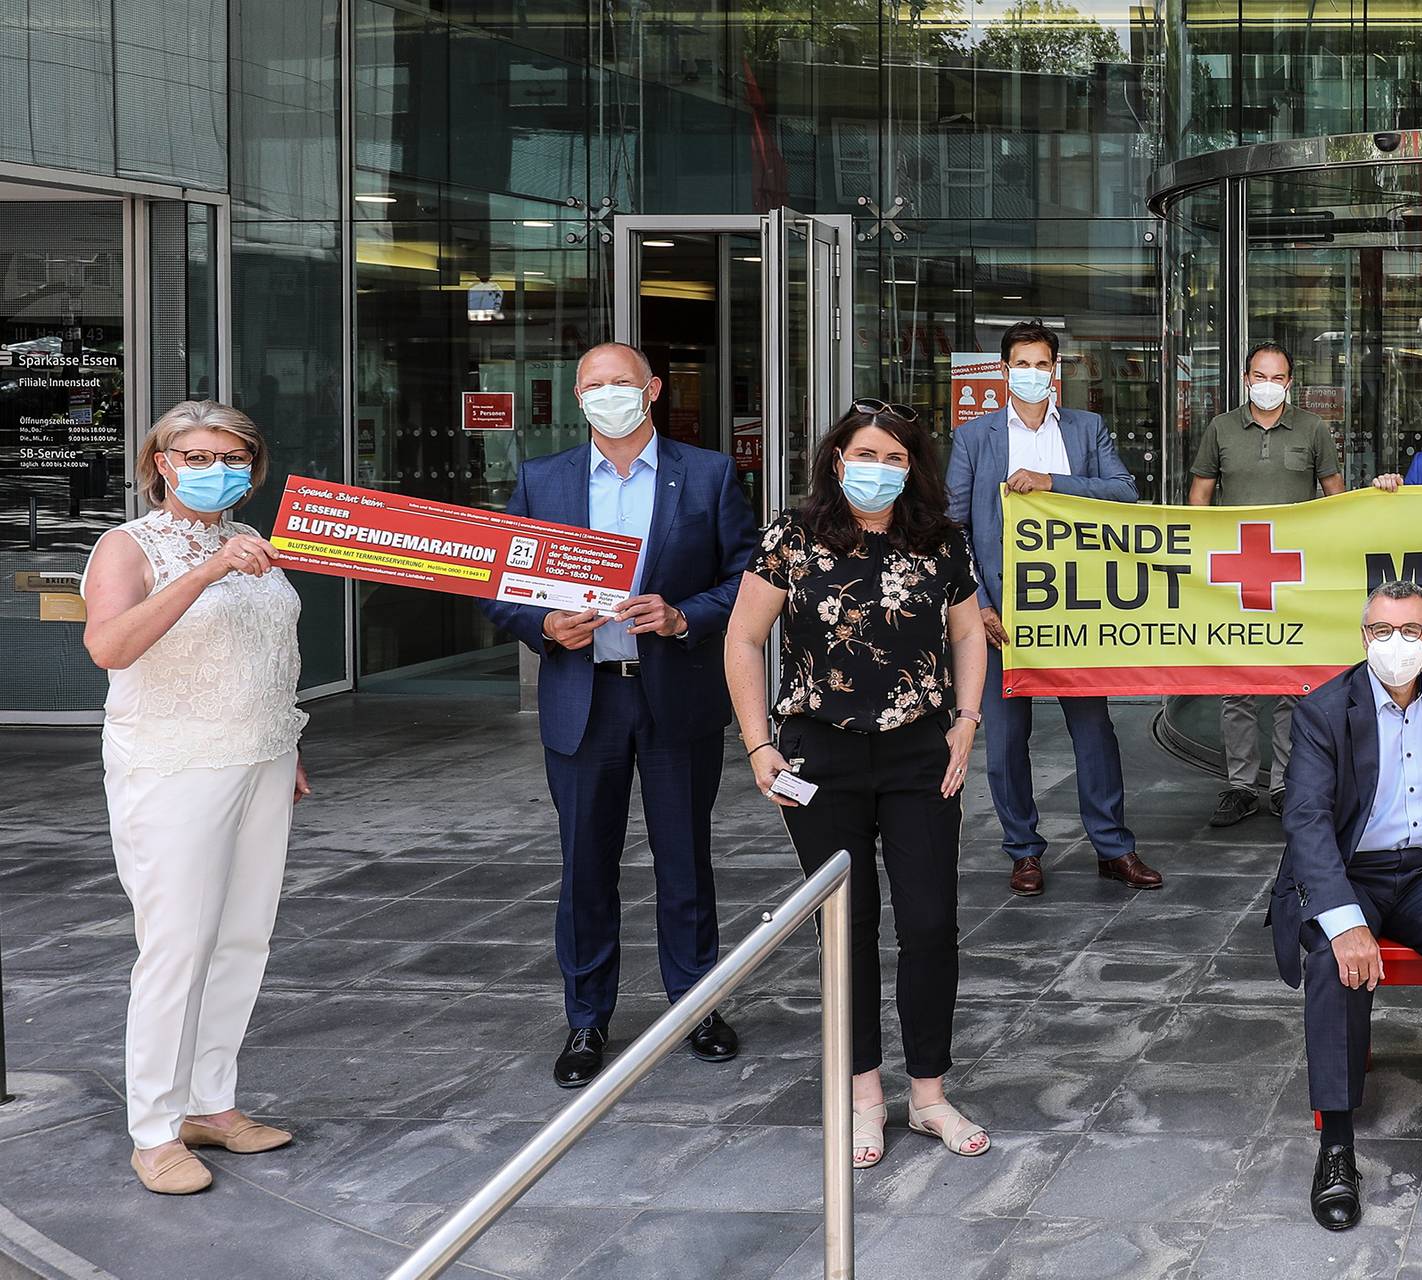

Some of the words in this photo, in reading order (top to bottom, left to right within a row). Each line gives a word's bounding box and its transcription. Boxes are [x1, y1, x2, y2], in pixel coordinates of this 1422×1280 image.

[18, 355, 79, 368] Sparkasse
[82, 355, 117, 366] Essen
[19, 377, 47, 387] Filiale
[49, 377, 101, 387] Innenstadt
[1306, 401, 1338, 409] Entrance
[20, 448, 76, 459] SB-Service
[297, 486, 333, 499] Spende
[336, 492, 360, 504] Blut
[292, 501, 302, 510] 3.
[304, 503, 350, 518] ESSENER
[286, 515, 497, 563] BLUTSPENDEMARATHON
[1015, 519, 1191, 555] SPENDE
[287, 542, 328, 554] BLUTSPENDE
[328, 547, 342, 555] NUR
[512, 545, 533, 559] 21.
[550, 543, 558, 551] In
[559, 543, 572, 552] der
[573, 545, 618, 560] Kundenhalle
[510, 557, 529, 567] Juni
[548, 551, 562, 560] der
[562, 552, 601, 565] Sparkasse
[601, 558, 624, 569] Essen
[557, 560, 582, 572] Hagen
[582, 563, 592, 572] 43
[589, 572, 604, 582] Uhr
[1015, 561, 1191, 611] BLUT
[1015, 624, 1087, 647] BEIM
[1100, 623, 1196, 646] ROTEN
[1208, 623, 1304, 645] KREUZ
